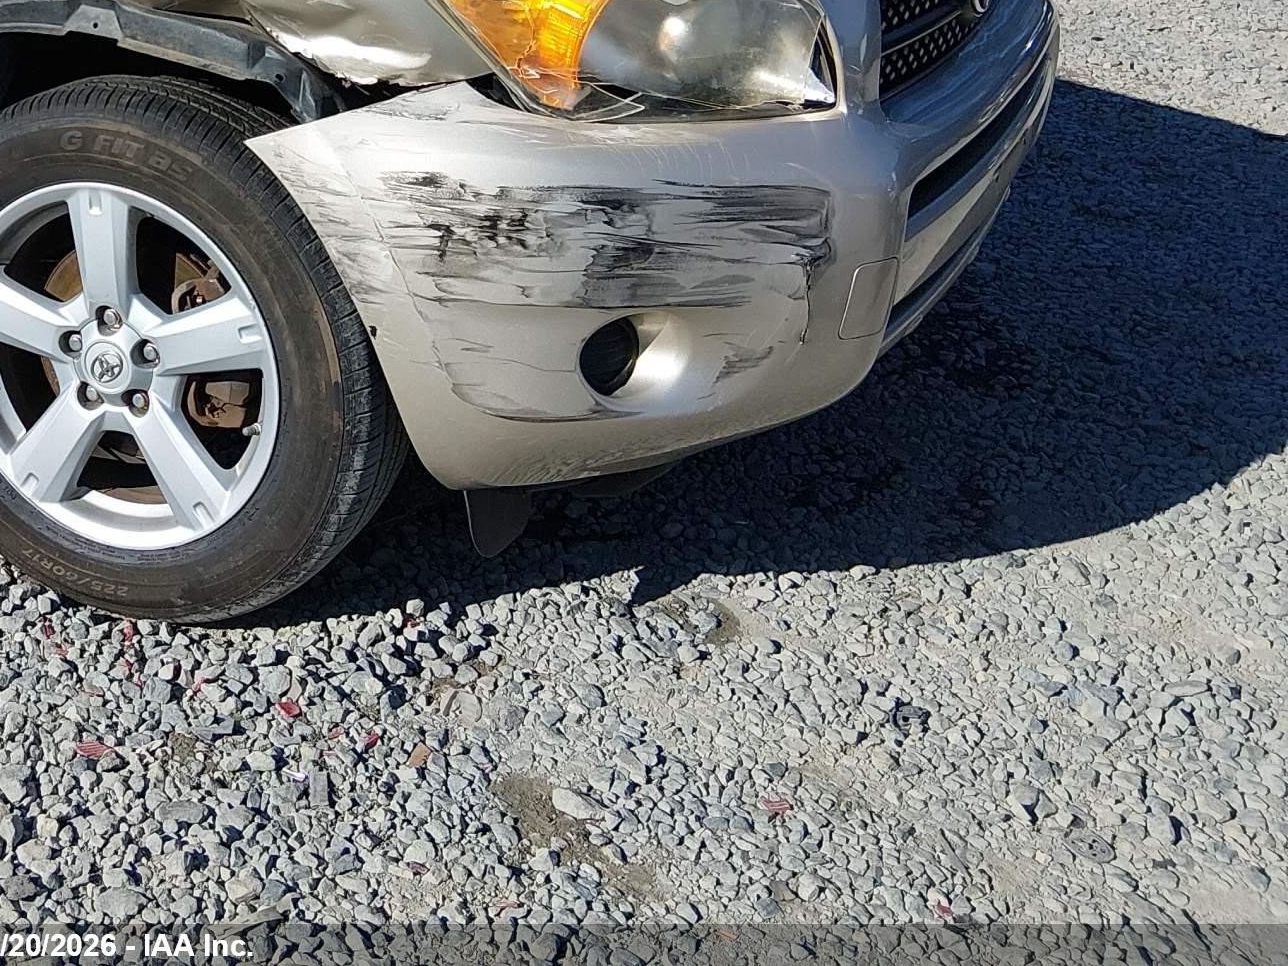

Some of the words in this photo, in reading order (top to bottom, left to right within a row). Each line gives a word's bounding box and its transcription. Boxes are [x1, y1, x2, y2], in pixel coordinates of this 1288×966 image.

[59, 130, 83, 151] G
[93, 134, 145, 158] FIT
[21, 548, 129, 597] 225/60R17
